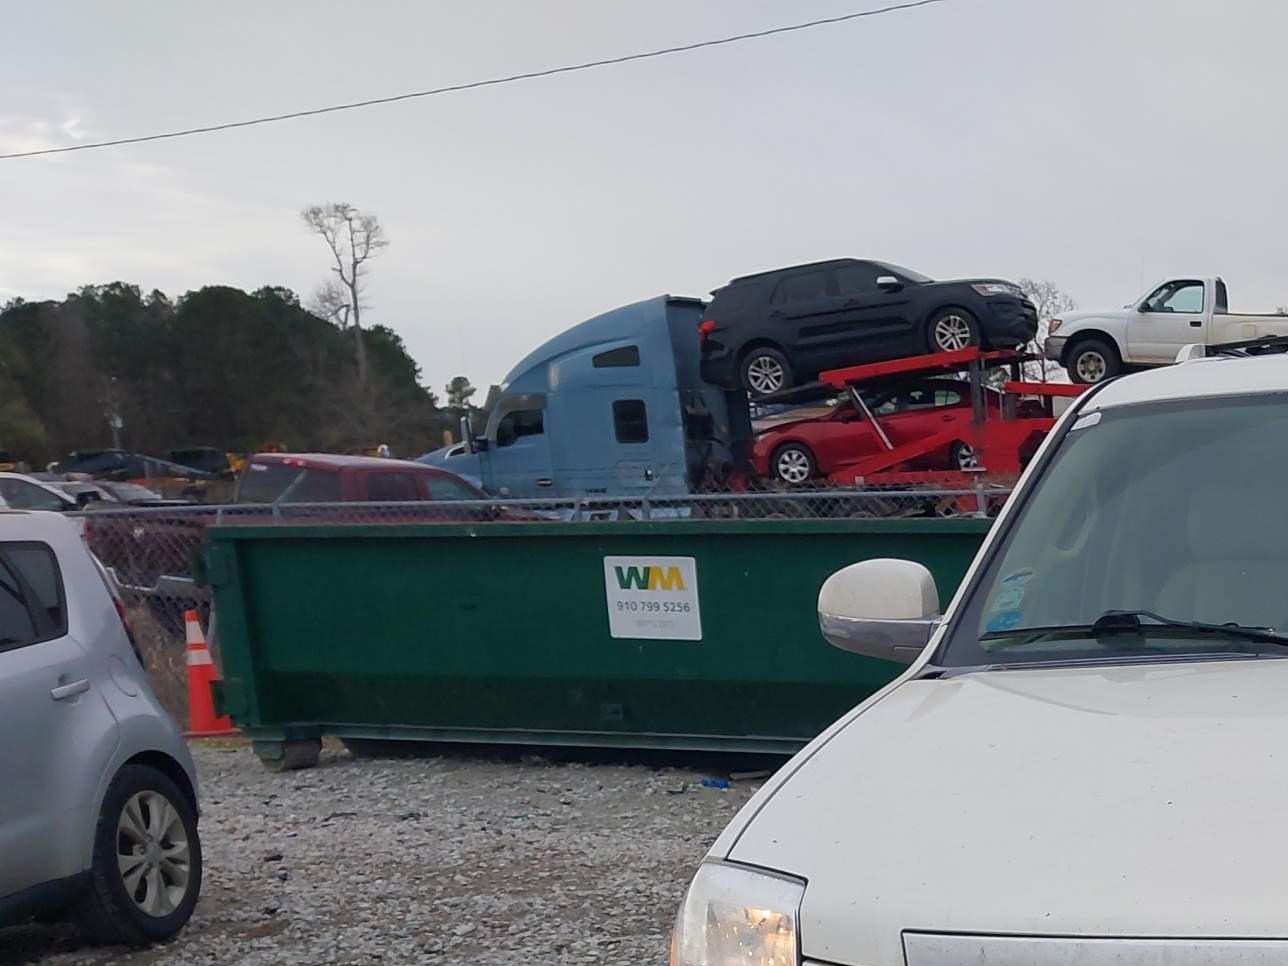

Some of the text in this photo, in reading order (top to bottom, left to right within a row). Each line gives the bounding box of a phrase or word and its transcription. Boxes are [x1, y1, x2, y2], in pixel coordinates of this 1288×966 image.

[614, 566, 685, 591] WM
[616, 601, 690, 613] 910 799 5256
